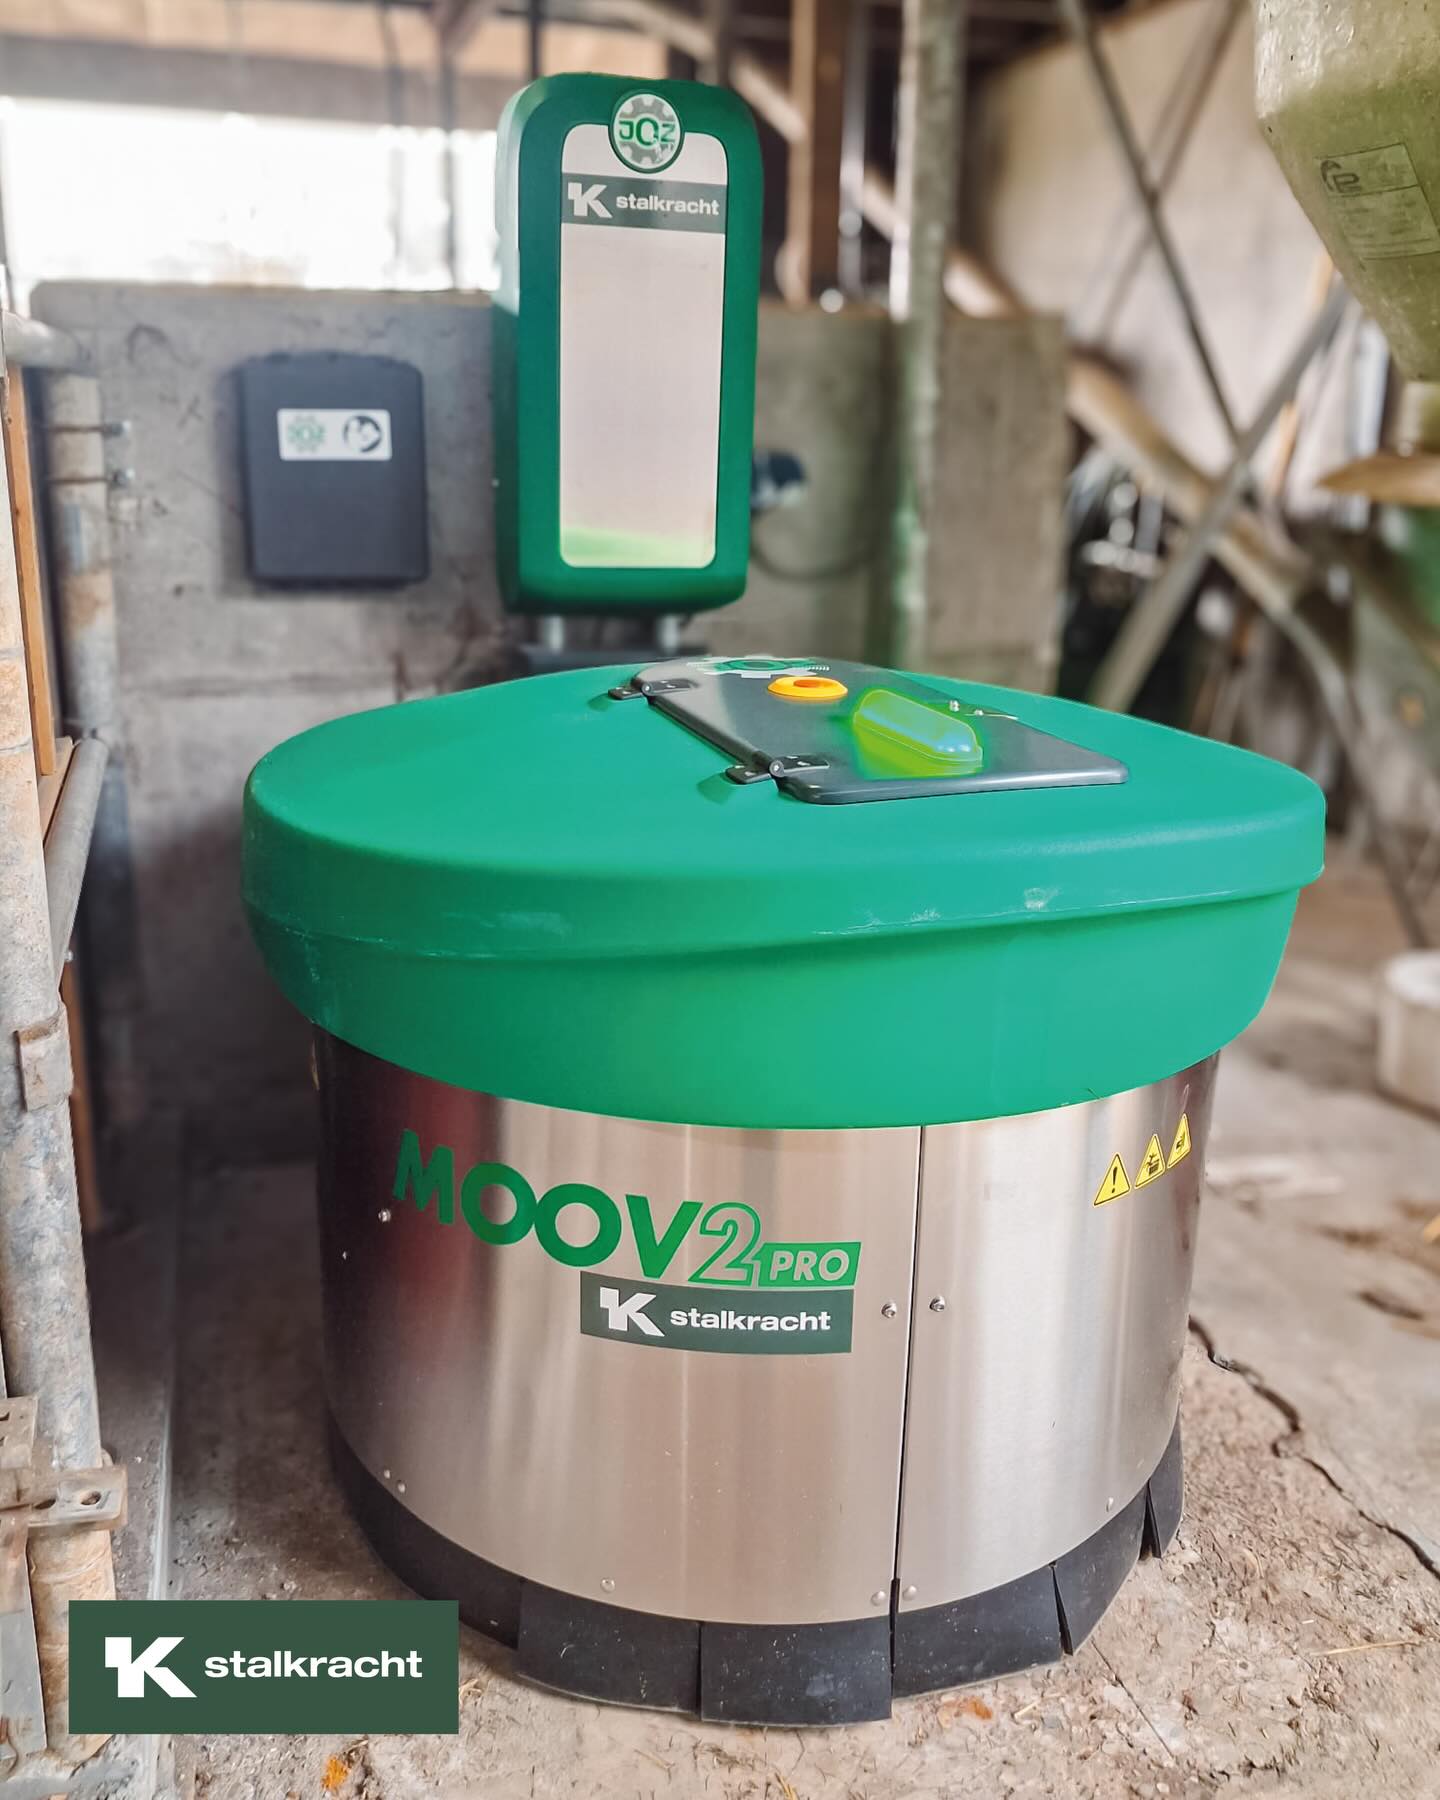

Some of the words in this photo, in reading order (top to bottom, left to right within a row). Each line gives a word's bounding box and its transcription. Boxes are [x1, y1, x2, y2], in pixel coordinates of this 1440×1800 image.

[618, 117, 677, 146] JOZ
[615, 193, 720, 216] stalkracht
[769, 1248, 850, 1282] PRO
[669, 1308, 831, 1332] stalkracht
